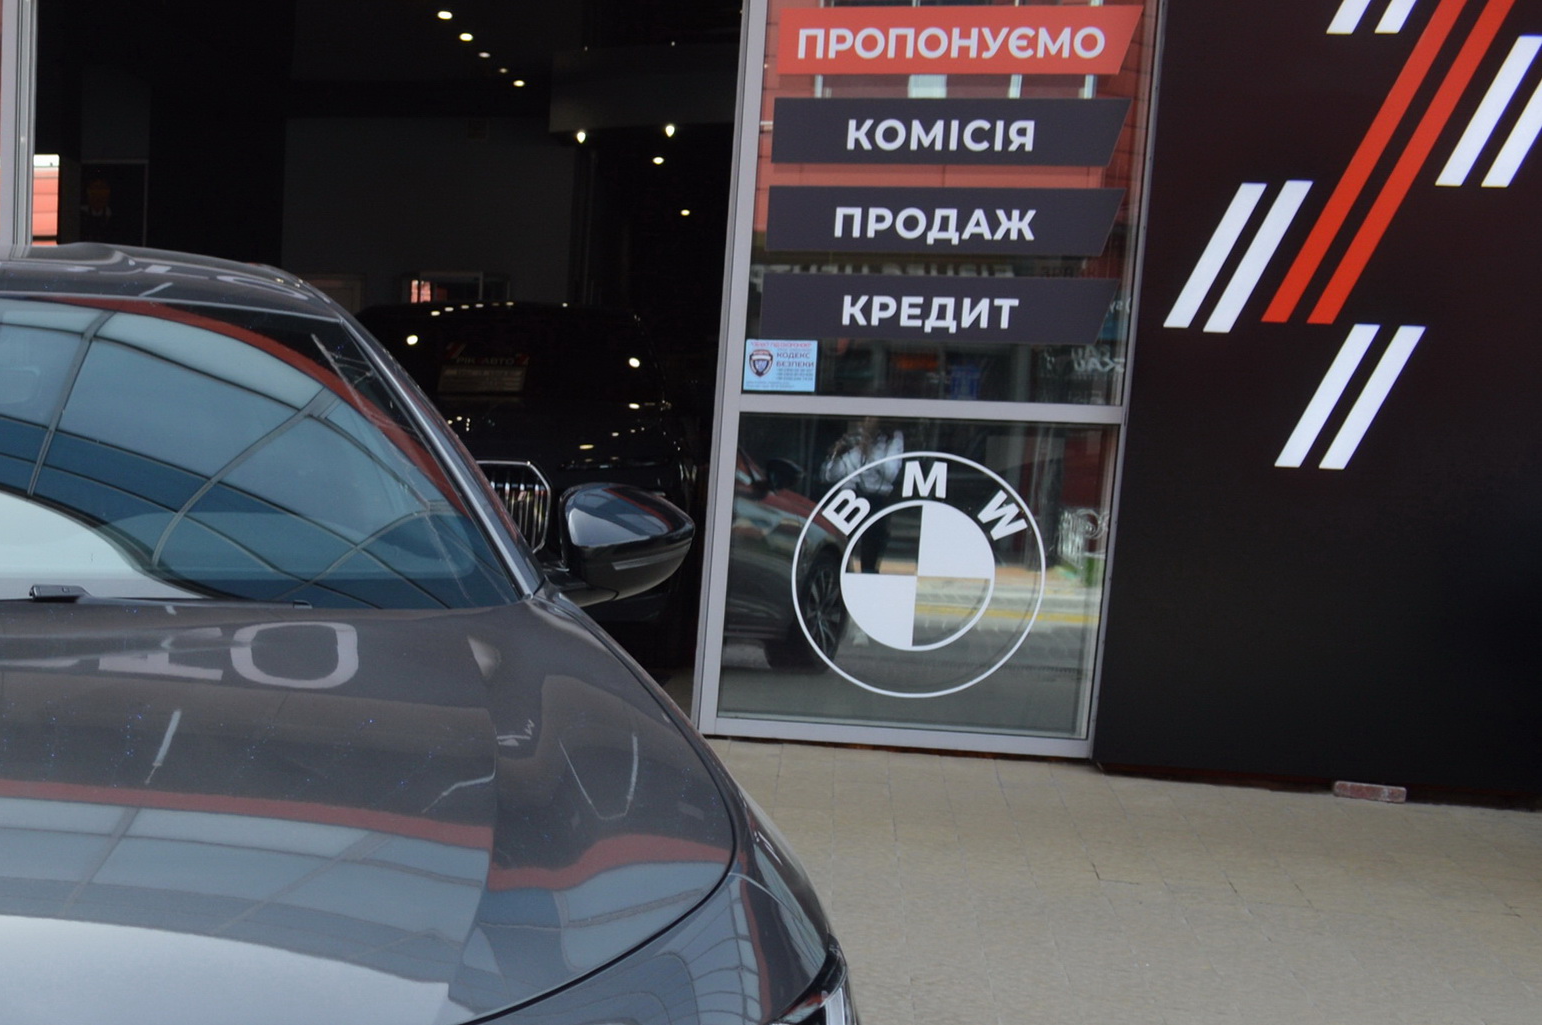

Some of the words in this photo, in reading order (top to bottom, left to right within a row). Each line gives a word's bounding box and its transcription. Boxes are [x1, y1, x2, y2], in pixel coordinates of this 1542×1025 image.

[797, 26, 1106, 60] ПРОПОНУЄМО
[846, 118, 1036, 152] КОМІСІЯ
[833, 206, 1037, 245] ПРОДАЖ
[841, 294, 1020, 333] КРЕДИТ
[821, 460, 1029, 542] BMW
